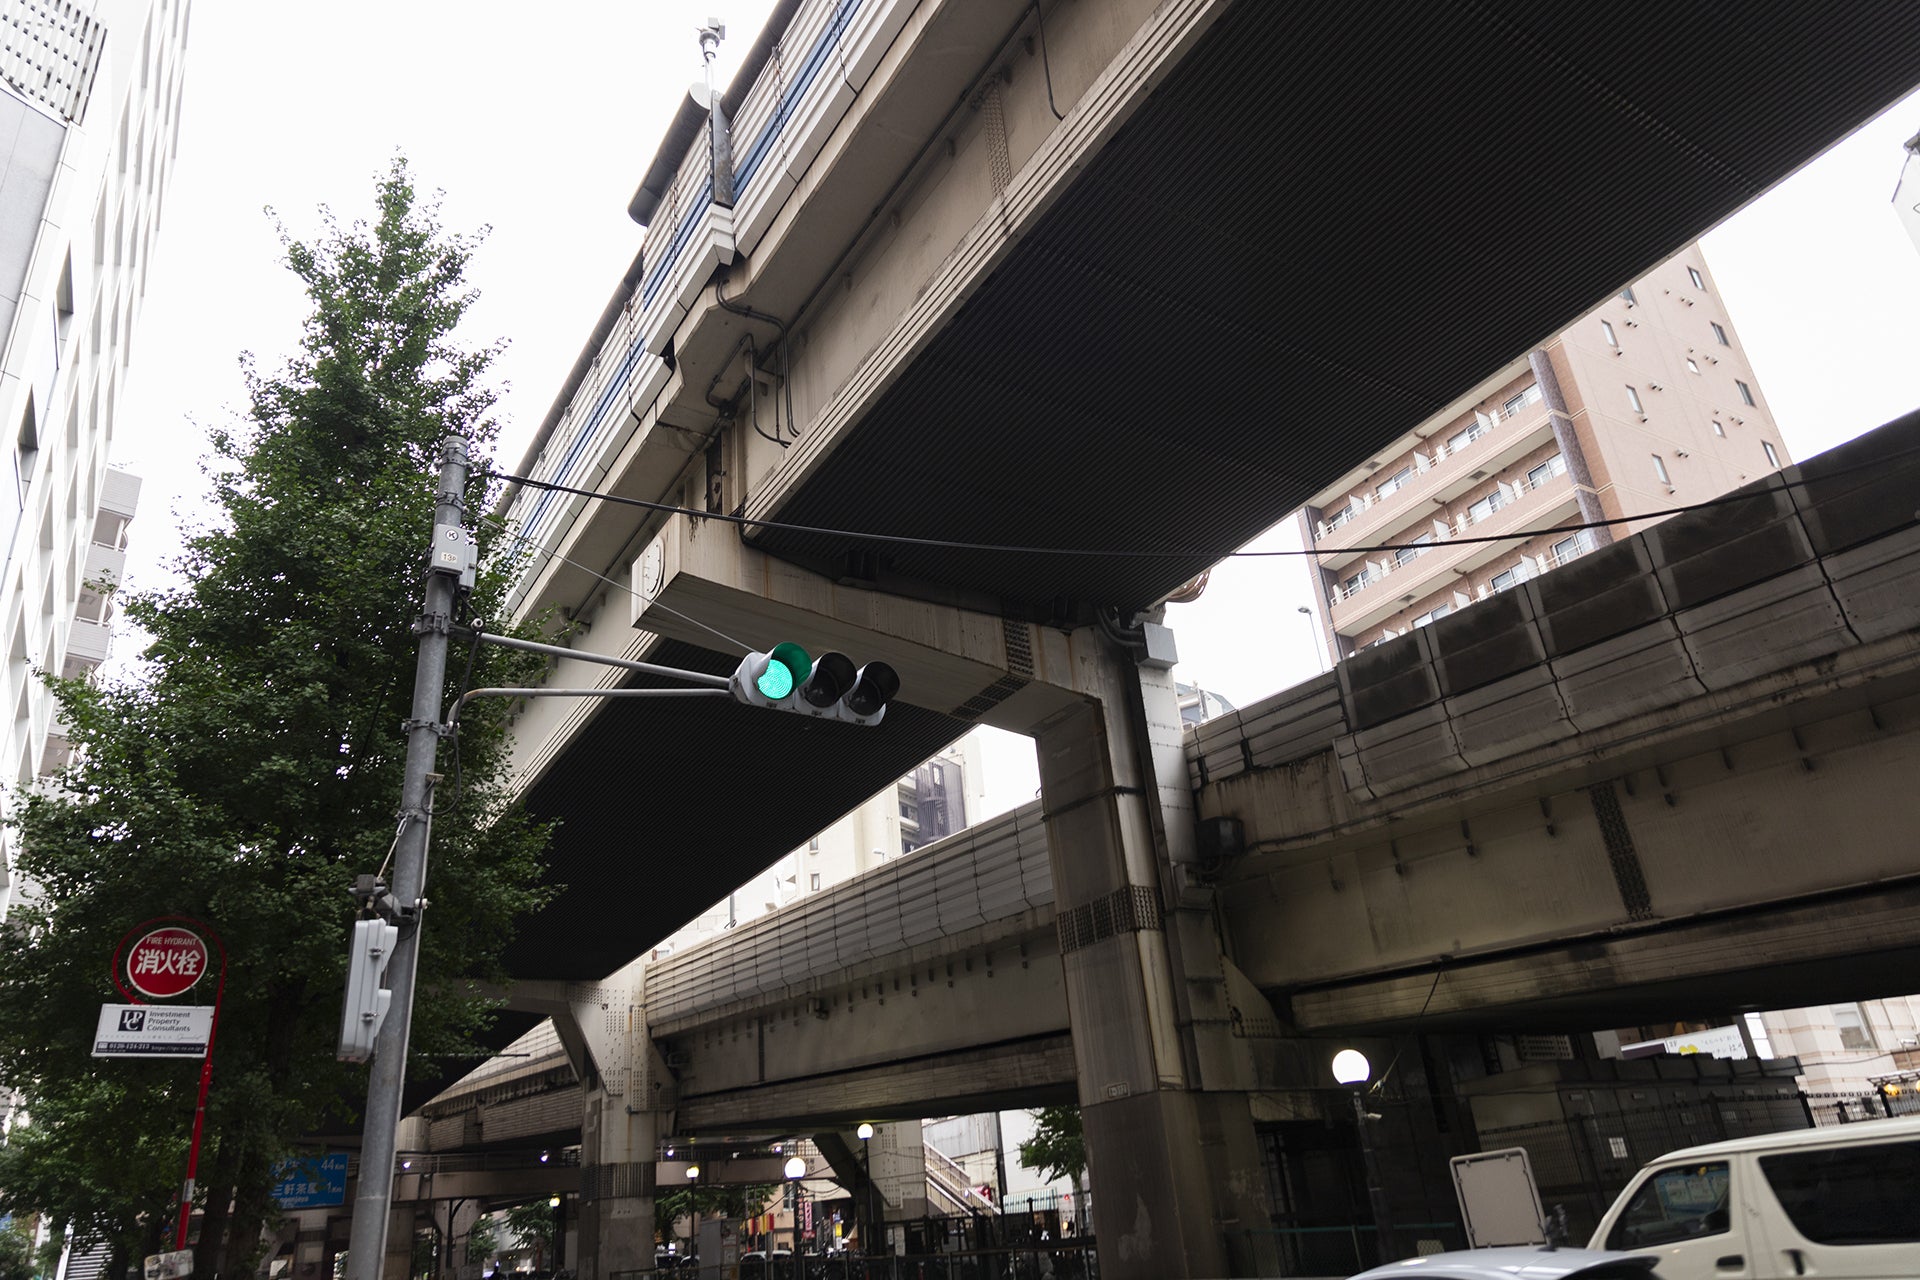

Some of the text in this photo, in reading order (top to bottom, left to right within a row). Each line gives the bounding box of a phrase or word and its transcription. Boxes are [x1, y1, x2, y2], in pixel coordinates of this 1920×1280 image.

[146, 936, 197, 946] FIRE HYDRANT
[135, 949, 201, 975] 消火栓
